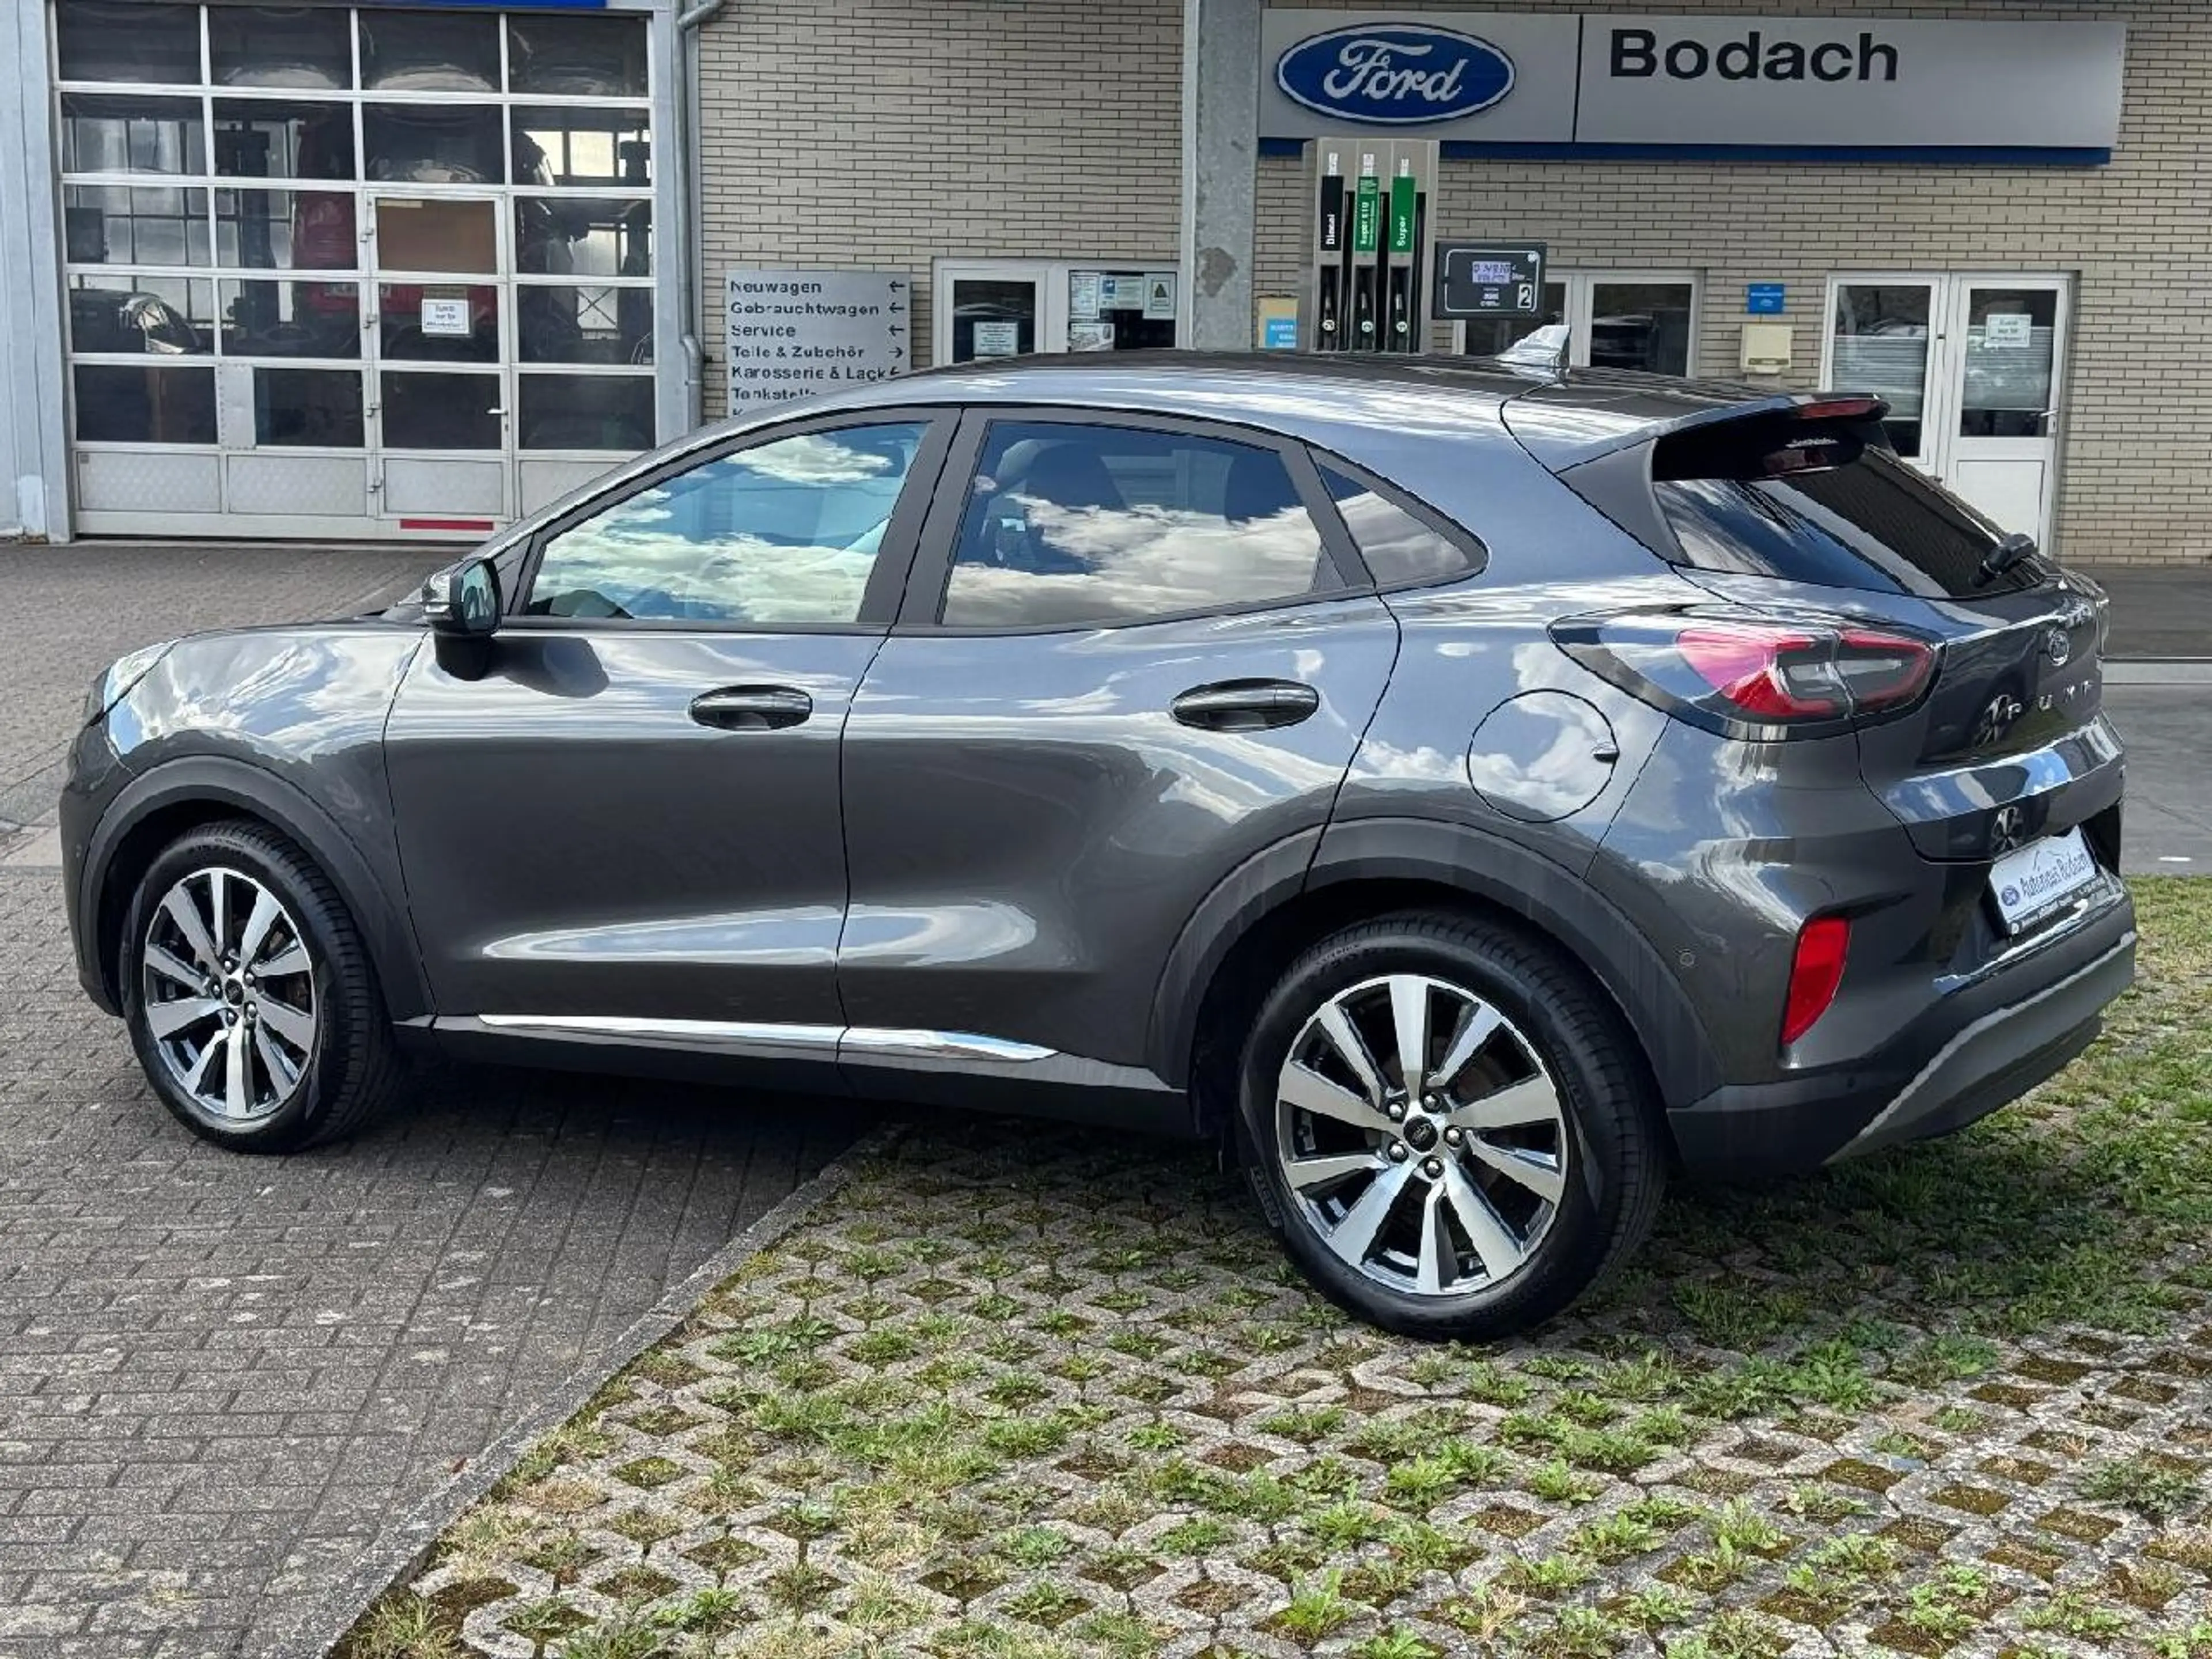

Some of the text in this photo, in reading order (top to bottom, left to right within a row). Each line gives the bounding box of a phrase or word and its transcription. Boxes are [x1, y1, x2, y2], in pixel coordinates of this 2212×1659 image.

[1610, 29, 1898, 81] Bodach
[1323, 39, 1468, 101] Ford
[1325, 214, 1336, 245] Diesel
[1396, 215, 1408, 247] Super
[730, 281, 822, 296] Neuwagen
[1520, 286, 1531, 306] 2
[730, 301, 880, 317] Gebrauchtwagen
[731, 324, 797, 338] Service
[732, 345, 865, 358] Teile & Zubehör
[732, 366, 887, 381] Karosserie & Lack
